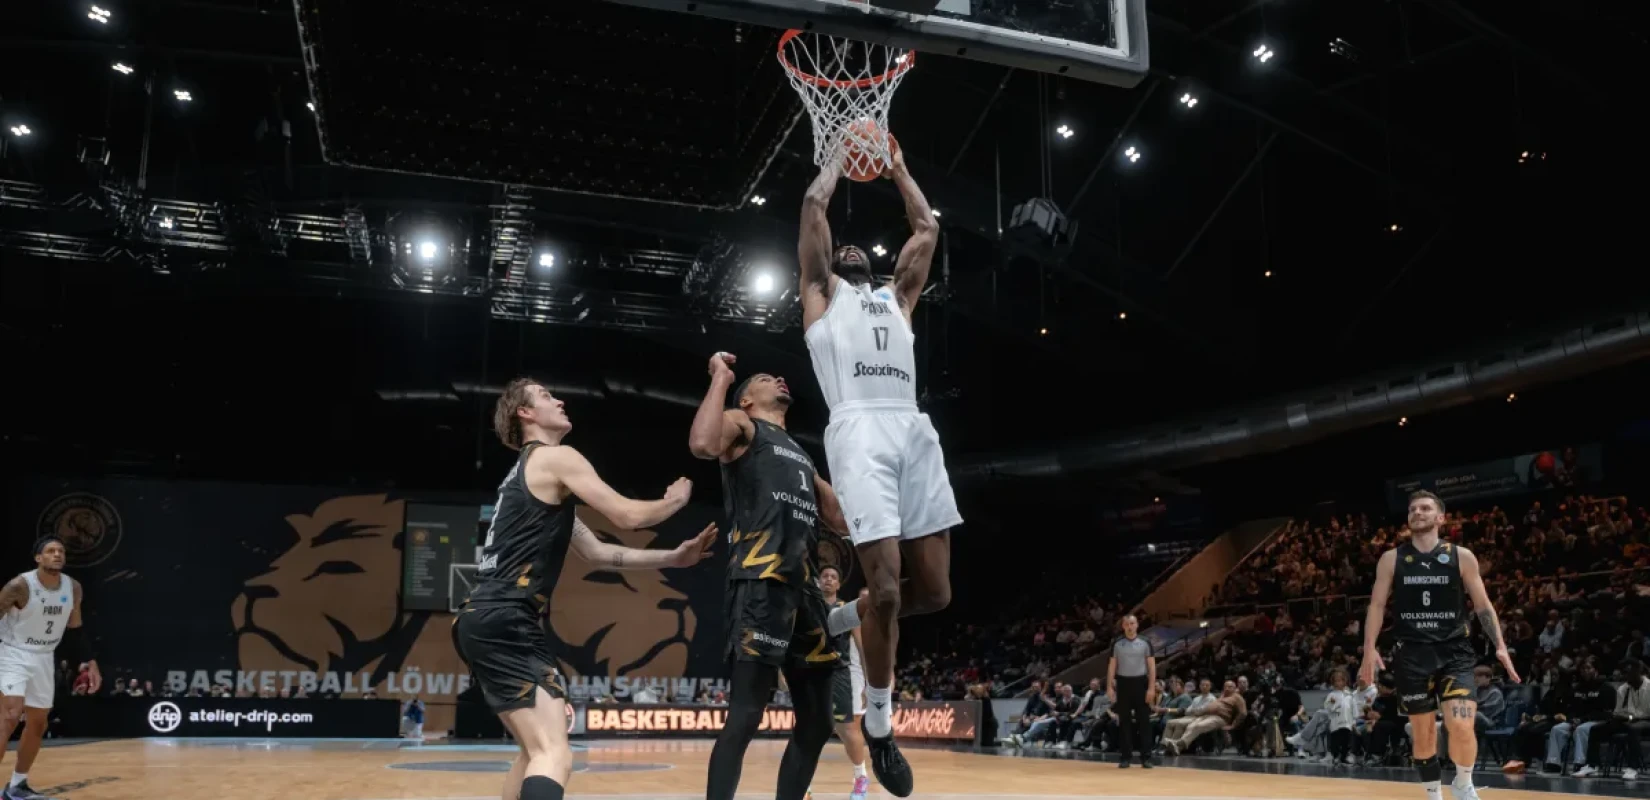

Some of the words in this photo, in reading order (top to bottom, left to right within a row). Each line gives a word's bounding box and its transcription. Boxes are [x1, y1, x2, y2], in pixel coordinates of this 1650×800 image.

[872, 327, 889, 351] 17
[798, 469, 809, 492] 1
[793, 509, 815, 527] BANK
[1422, 591, 1431, 606] 6
[1400, 612, 1456, 620] VOLKSWAGEN
[45, 620, 54, 635] 2
[168, 670, 373, 694] BASKETBALL
[151, 701, 180, 731] drip
[189, 708, 313, 732] atelier-drip.com
[587, 709, 728, 731] BASKETBAL
